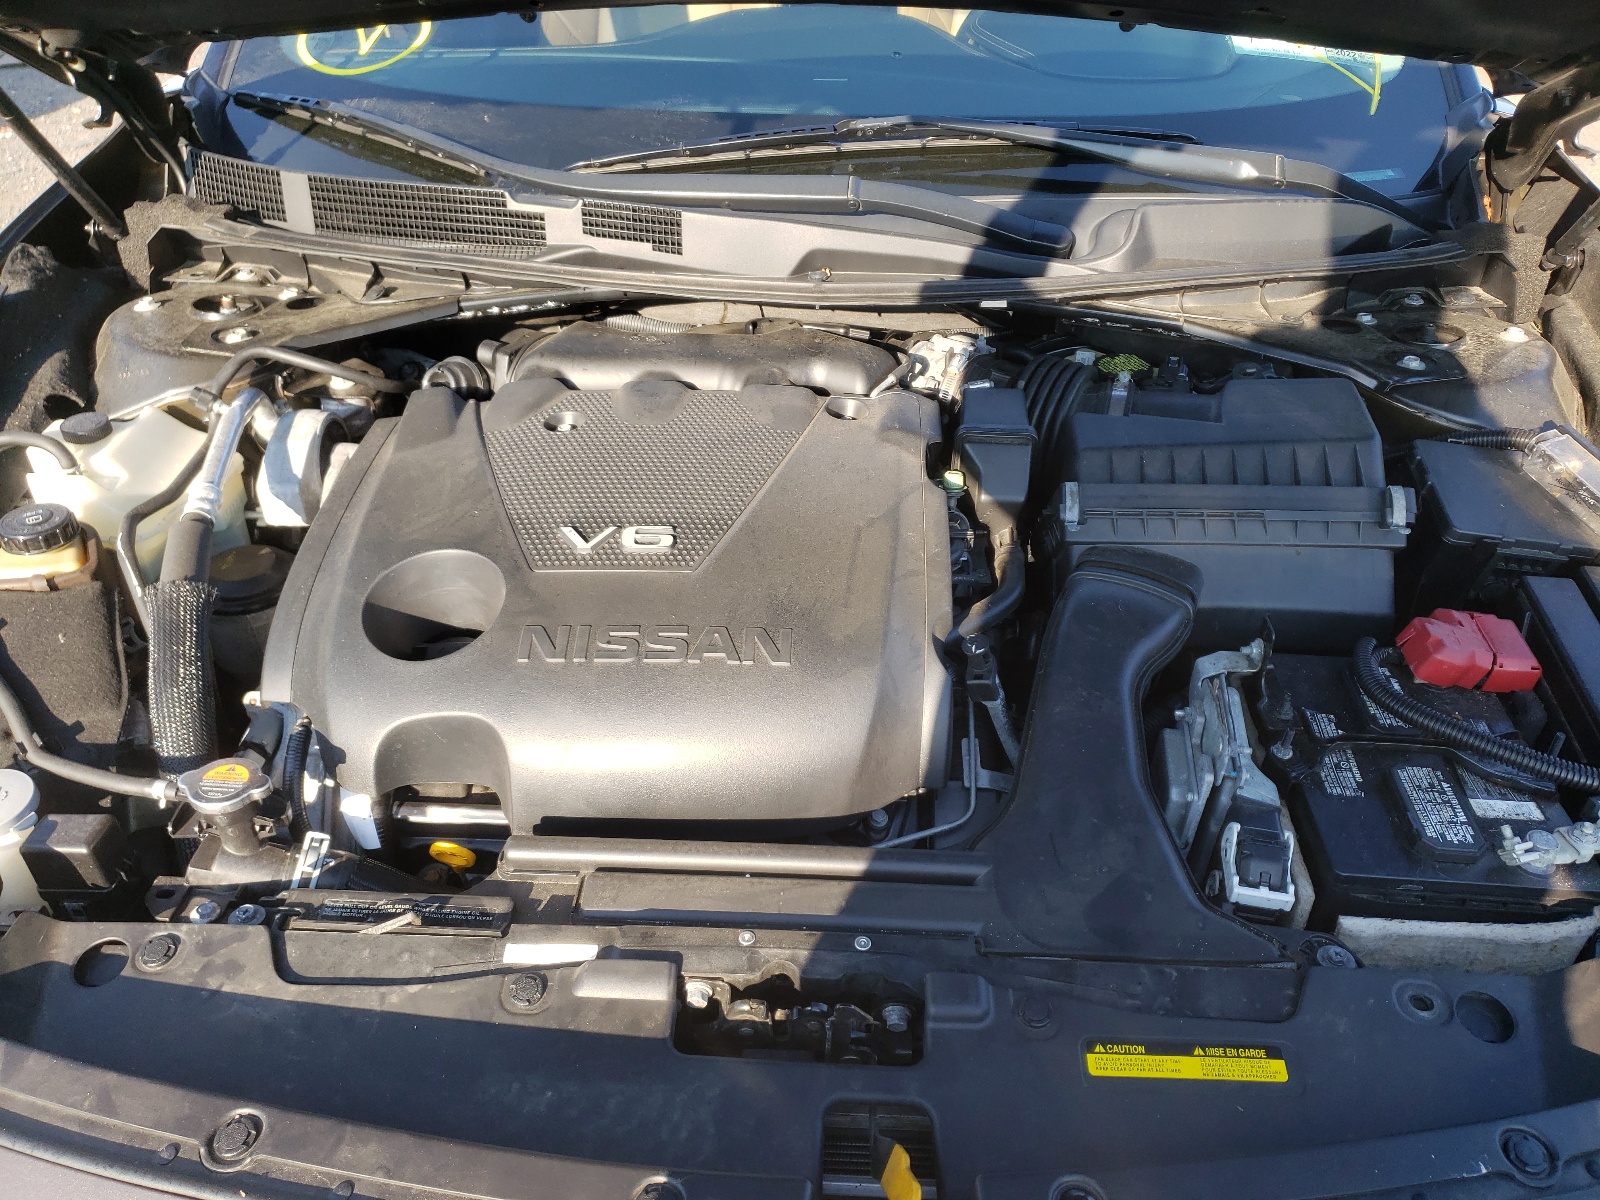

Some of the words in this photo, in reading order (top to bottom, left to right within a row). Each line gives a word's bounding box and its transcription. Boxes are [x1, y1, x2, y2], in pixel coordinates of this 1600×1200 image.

[559, 525, 677, 554] V6
[518, 624, 793, 666] NISSAN
[1106, 1044, 1146, 1054] CAUTION
[1206, 1047, 1225, 1056] MISE
[1226, 1048, 1237, 1057] EN
[1239, 1048, 1267, 1058] GARDE
